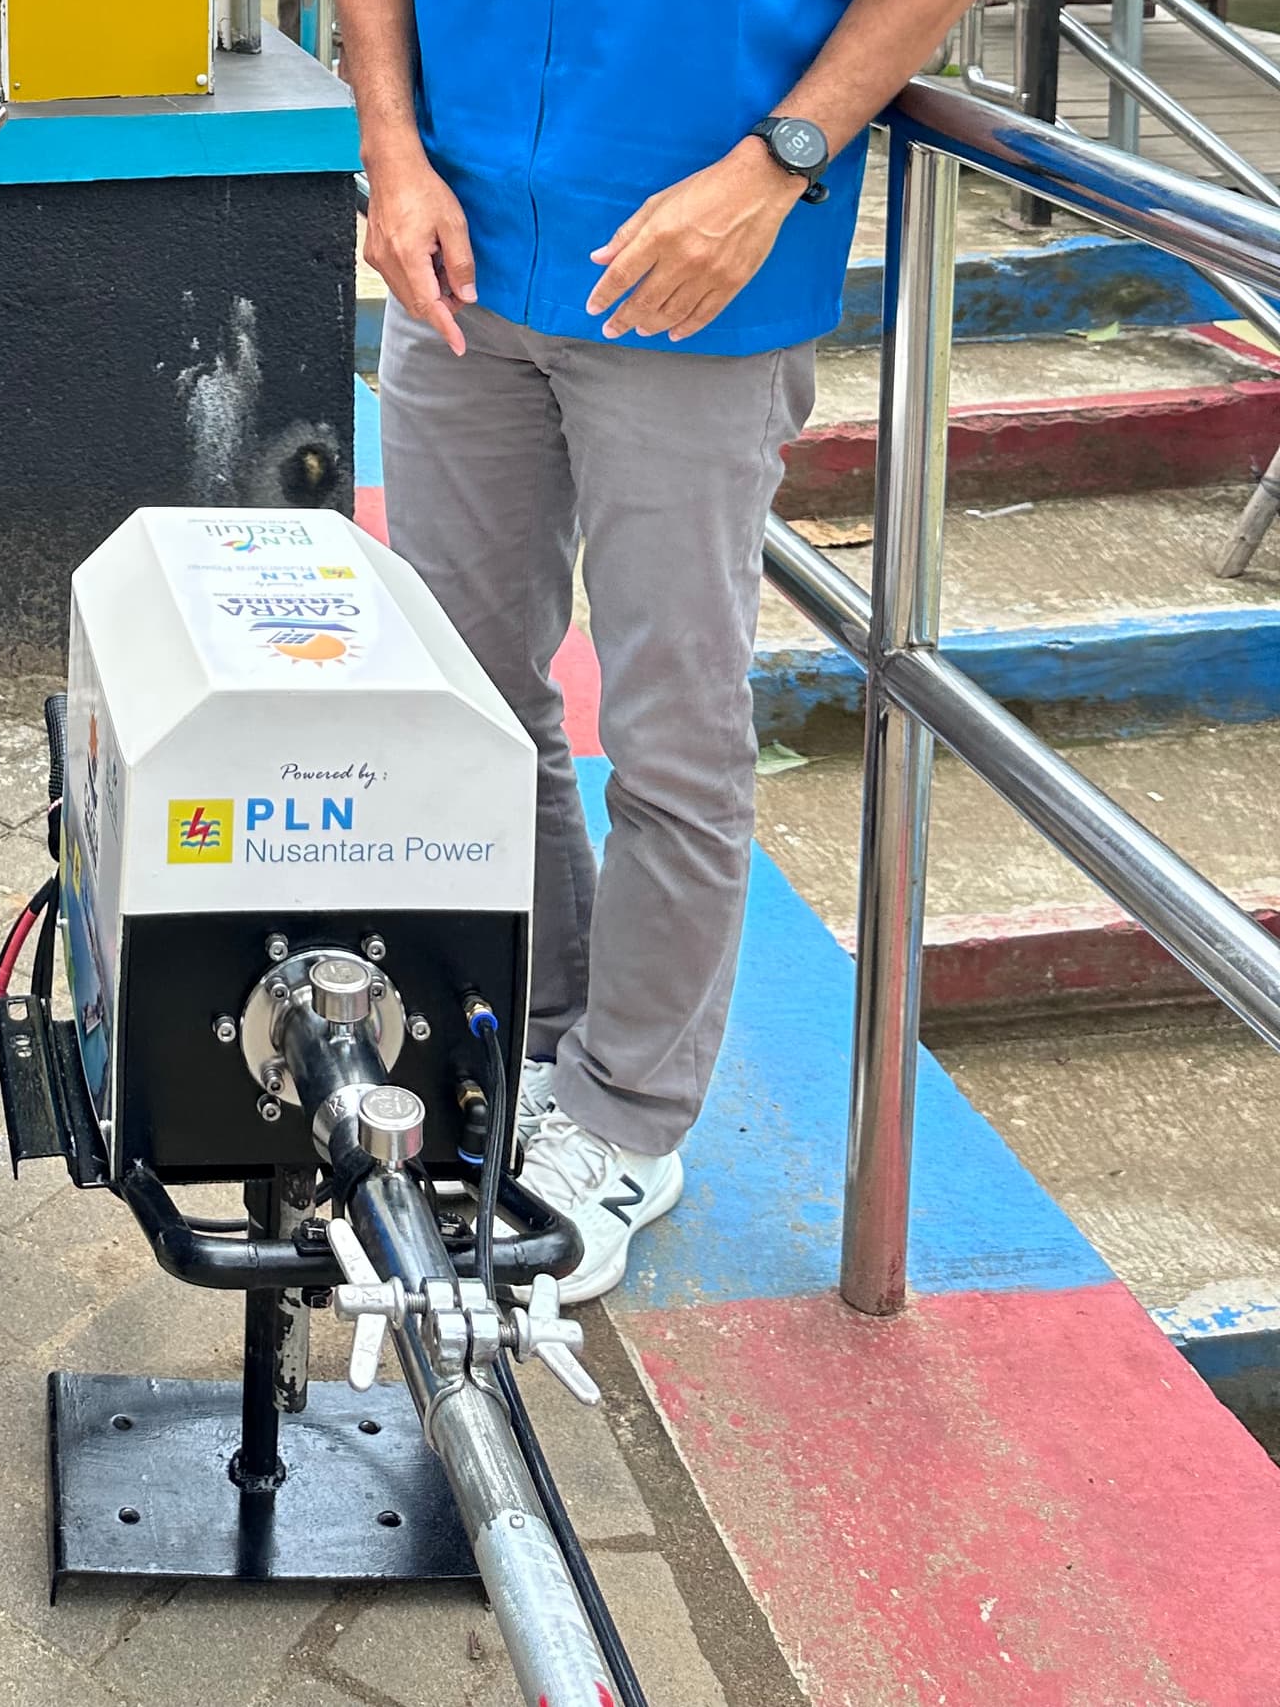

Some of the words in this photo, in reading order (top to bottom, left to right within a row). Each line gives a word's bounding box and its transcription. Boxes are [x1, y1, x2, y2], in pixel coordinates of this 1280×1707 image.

[205, 525, 308, 544] Peduli
[262, 536, 313, 546] PLN
[261, 572, 317, 581] PLN
[217, 604, 361, 617] CAKRA
[280, 762, 353, 780] Powered
[246, 797, 354, 831] PLN
[245, 837, 395, 863] Nusantara
[405, 836, 496, 862] Power
